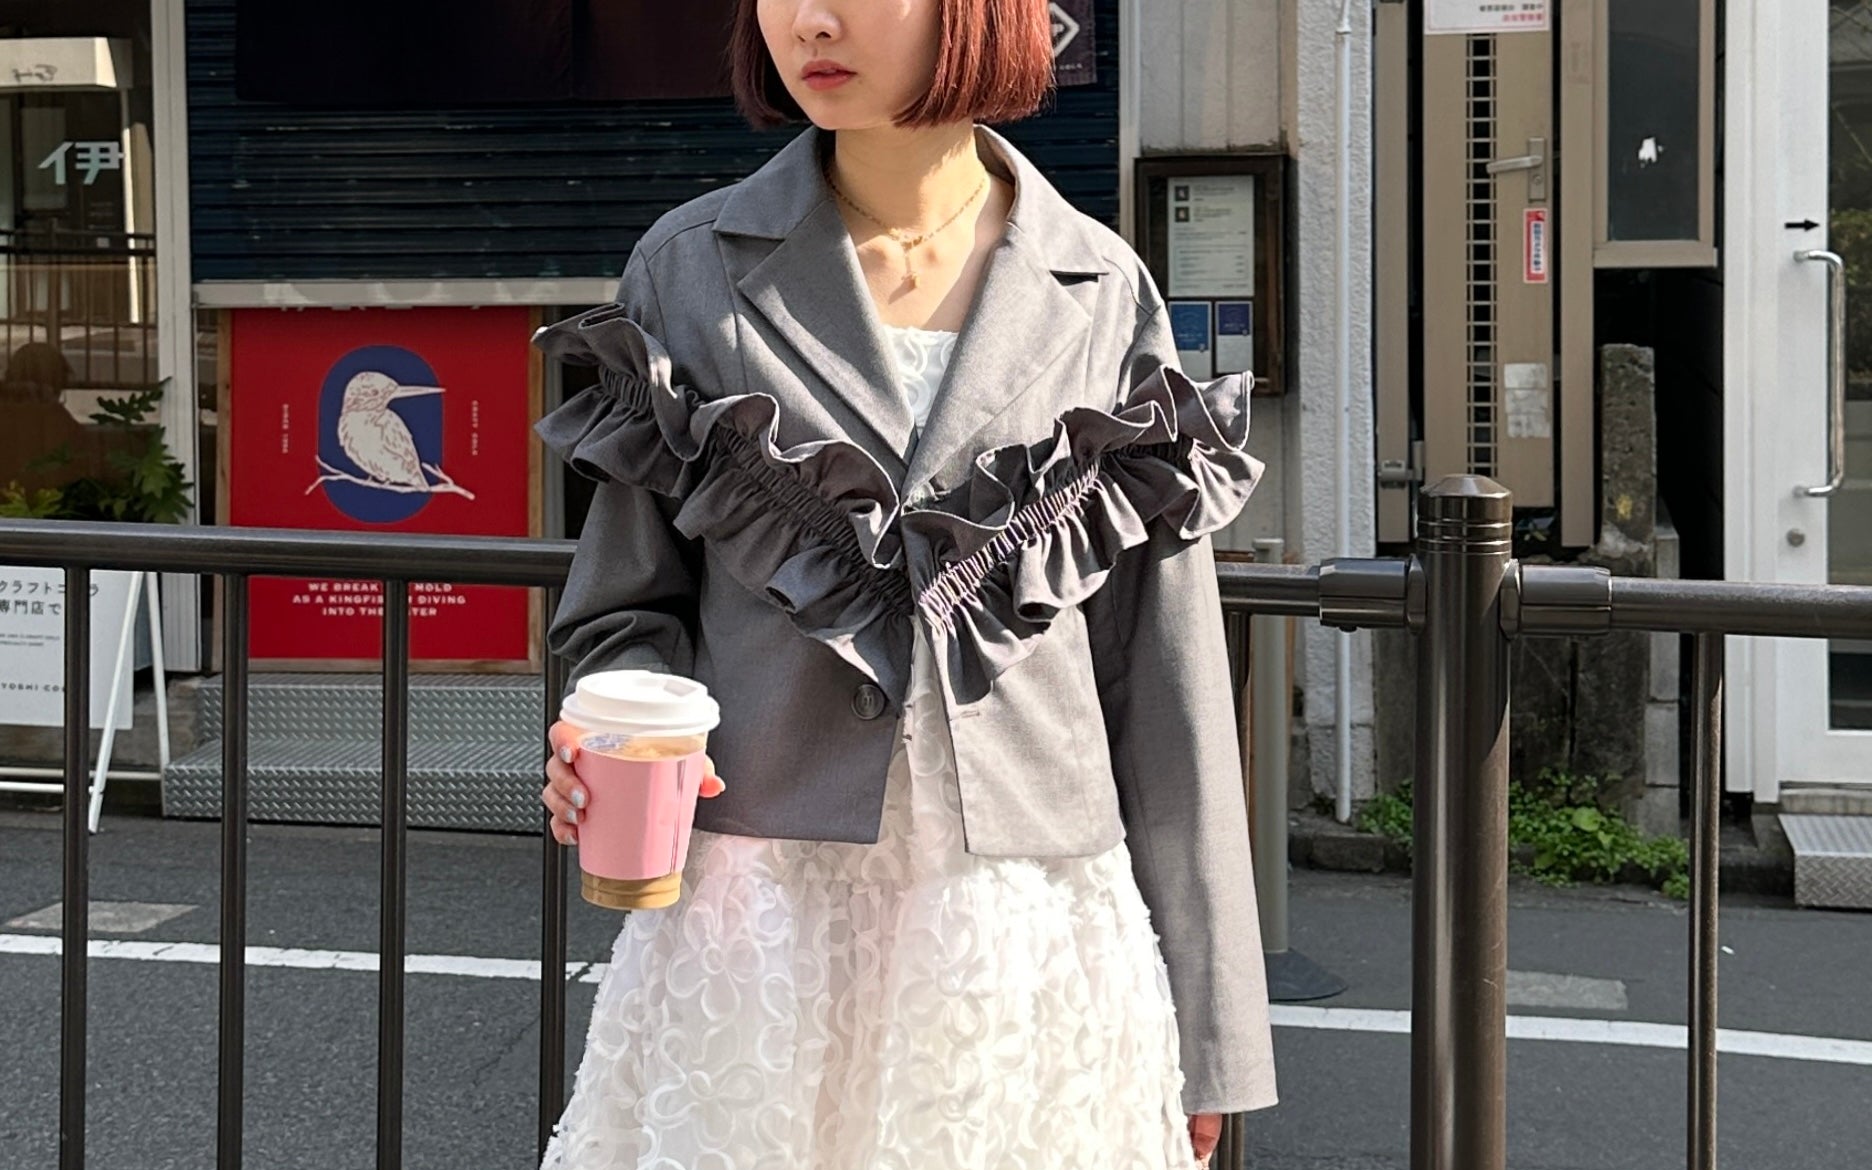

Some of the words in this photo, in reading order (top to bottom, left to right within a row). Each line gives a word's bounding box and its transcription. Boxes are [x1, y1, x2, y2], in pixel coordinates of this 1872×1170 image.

[38, 141, 125, 185] 伊
[0, 579, 99, 596] クラフトコラ
[308, 583, 328, 592] WE
[333, 583, 379, 592] BREAK
[414, 583, 452, 592] MOLD
[292, 595, 311, 604] AS
[315, 595, 324, 604] A
[418, 595, 466, 604] DIVING
[322, 607, 355, 616] INTO
